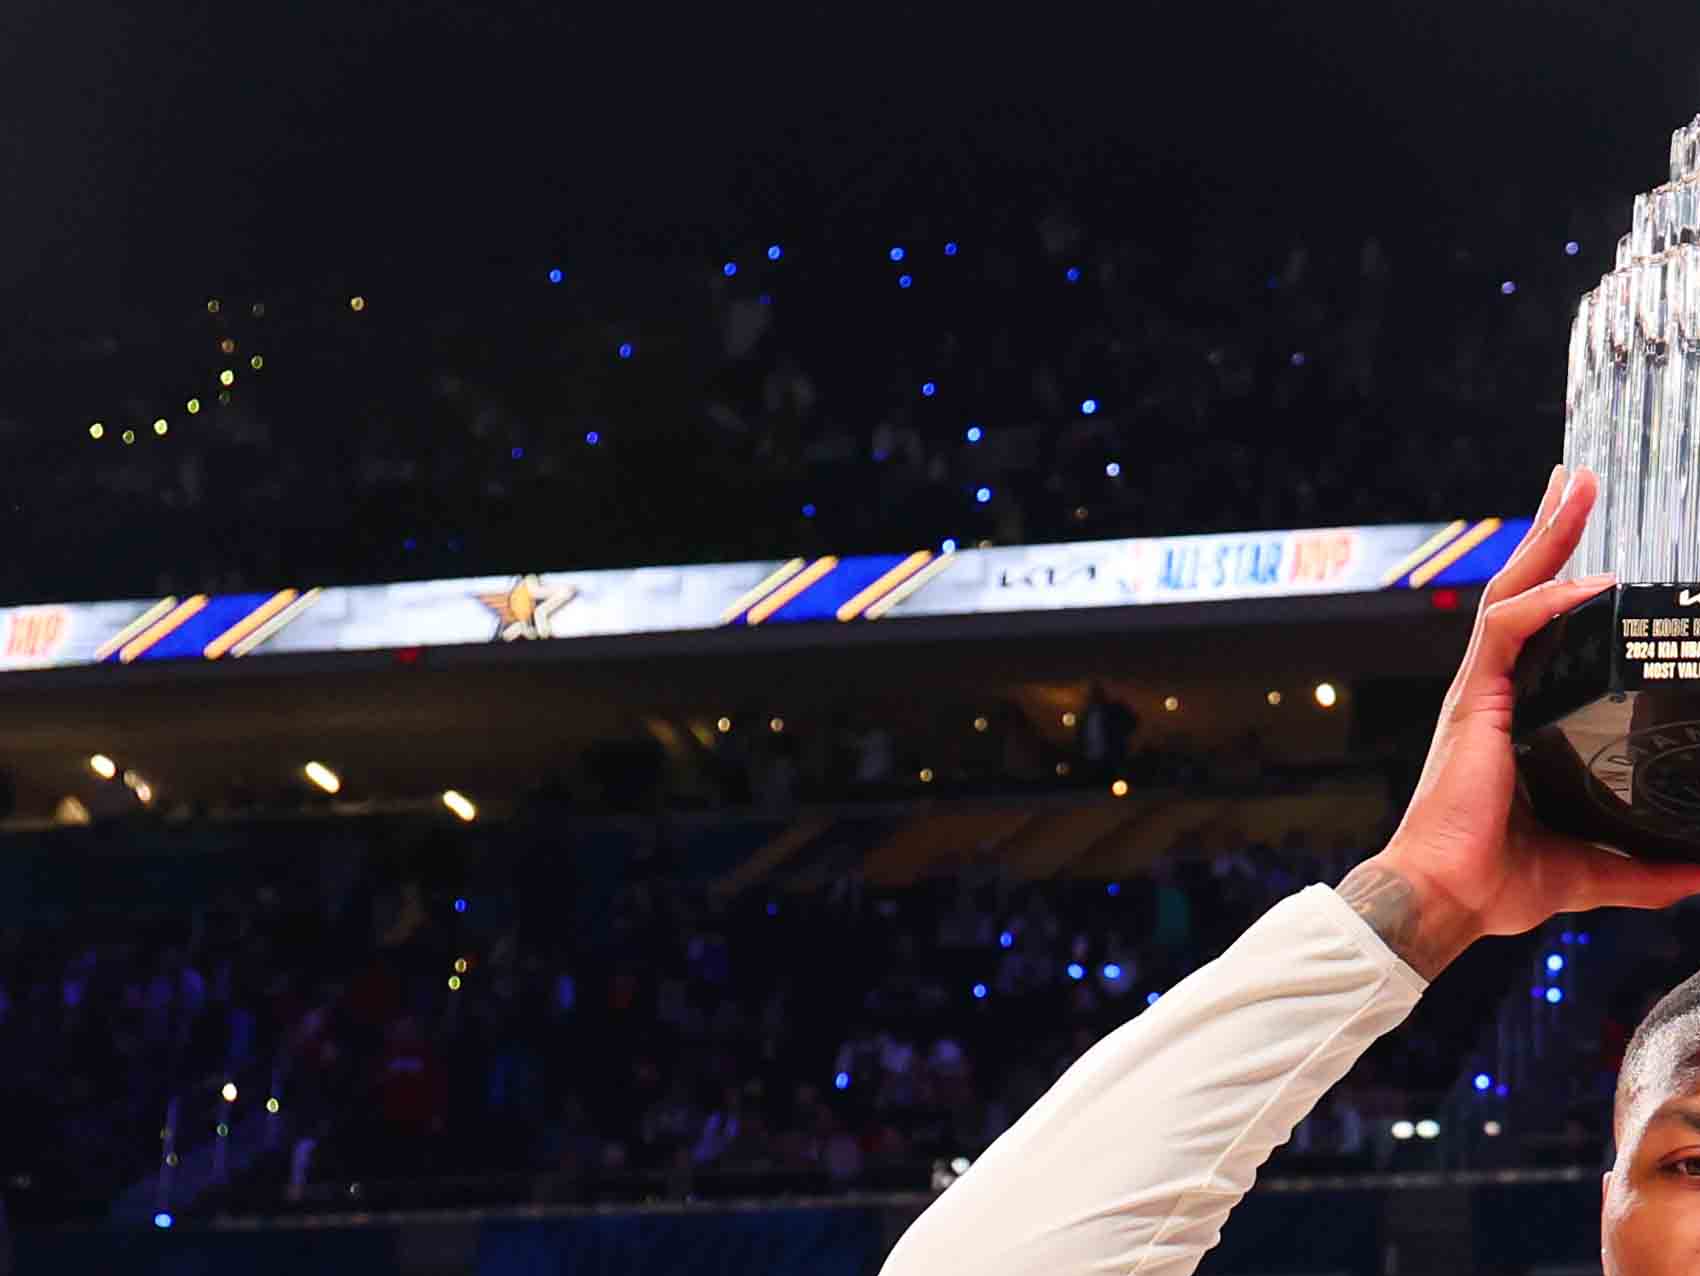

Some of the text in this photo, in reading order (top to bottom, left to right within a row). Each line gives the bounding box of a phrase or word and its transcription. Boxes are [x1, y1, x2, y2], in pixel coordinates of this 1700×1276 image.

[1622, 618, 1649, 637] THE
[1652, 617, 1689, 637] KOBE
[1625, 641, 1655, 659] 2024
[1658, 641, 1678, 659] KIA
[1643, 661, 1676, 679] MOST
